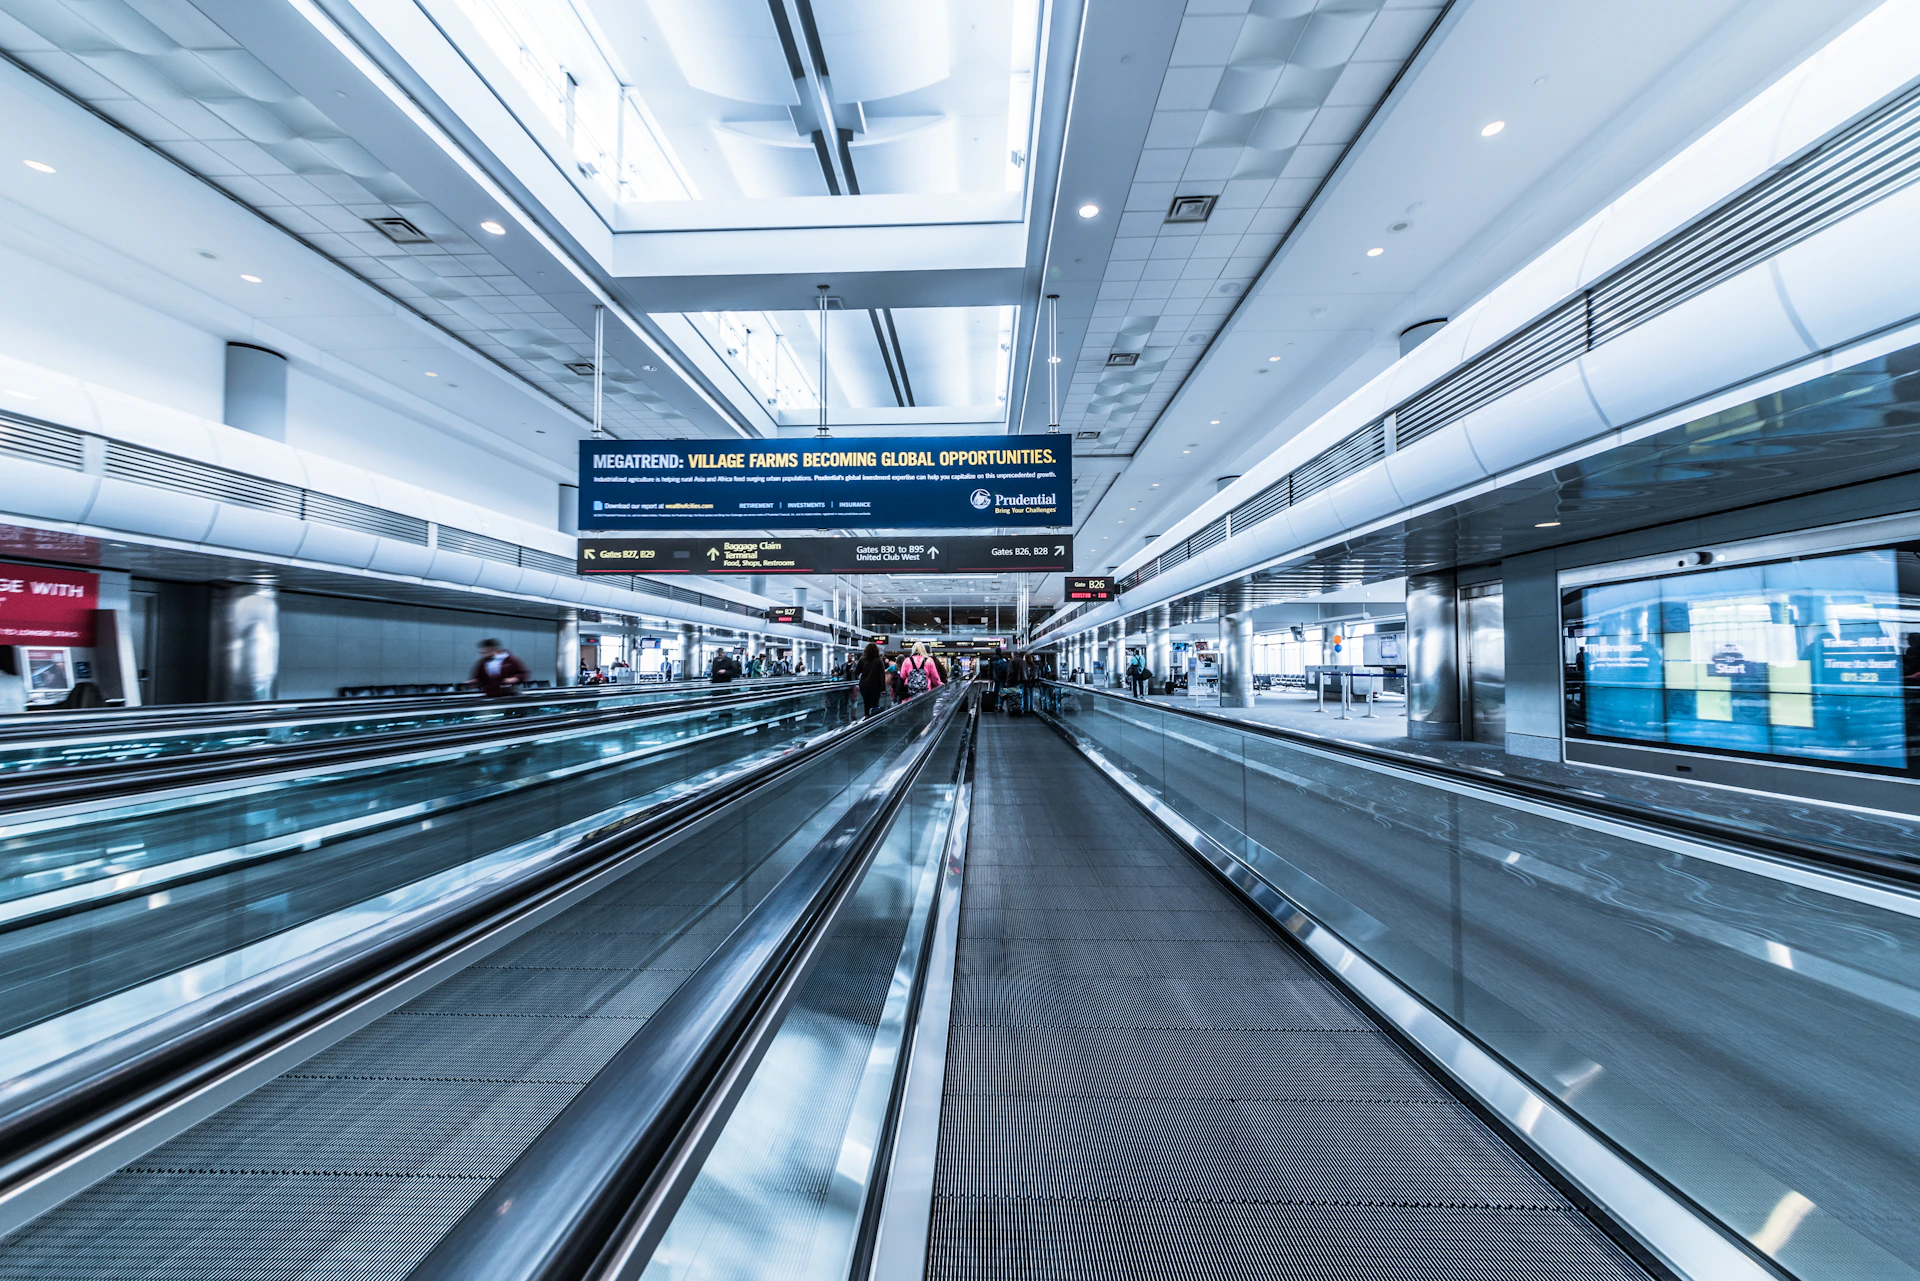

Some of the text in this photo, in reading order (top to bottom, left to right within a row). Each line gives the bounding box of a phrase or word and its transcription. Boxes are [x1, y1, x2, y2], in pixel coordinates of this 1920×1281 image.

[593, 448, 1057, 469] MEGATREND: VILLAGE FARMS BECOMING GLOBAL OPPORTUNITIES.
[746, 475, 765, 483] surging
[782, 475, 813, 483] populations.
[845, 474, 861, 482] global
[891, 474, 915, 482] expertise
[927, 473, 939, 481] help
[951, 473, 976, 481] capitalize
[996, 472, 1035, 480] unprecedented
[994, 493, 1057, 506] Prudential
[641, 503, 661, 511] report
[994, 507, 1011, 515] Bring
[723, 542, 782, 552] Baggage Claim
[856, 546, 879, 554] Gates
[909, 545, 924, 553] B95
[991, 547, 1048, 557] Gates B26, B28
[600, 550, 656, 560] Gates B27, B29
[723, 551, 758, 559] Terminal
[856, 553, 920, 561] United Club West
[723, 559, 741, 568] Food,
[742, 559, 762, 568] Shops,
[29, 581, 84, 598] WITH
[1089, 580, 1105, 589] B26
[785, 608, 796, 616] B27
[1715, 663, 1746, 674] Start
[1823, 658, 1898, 669] Time to beat
